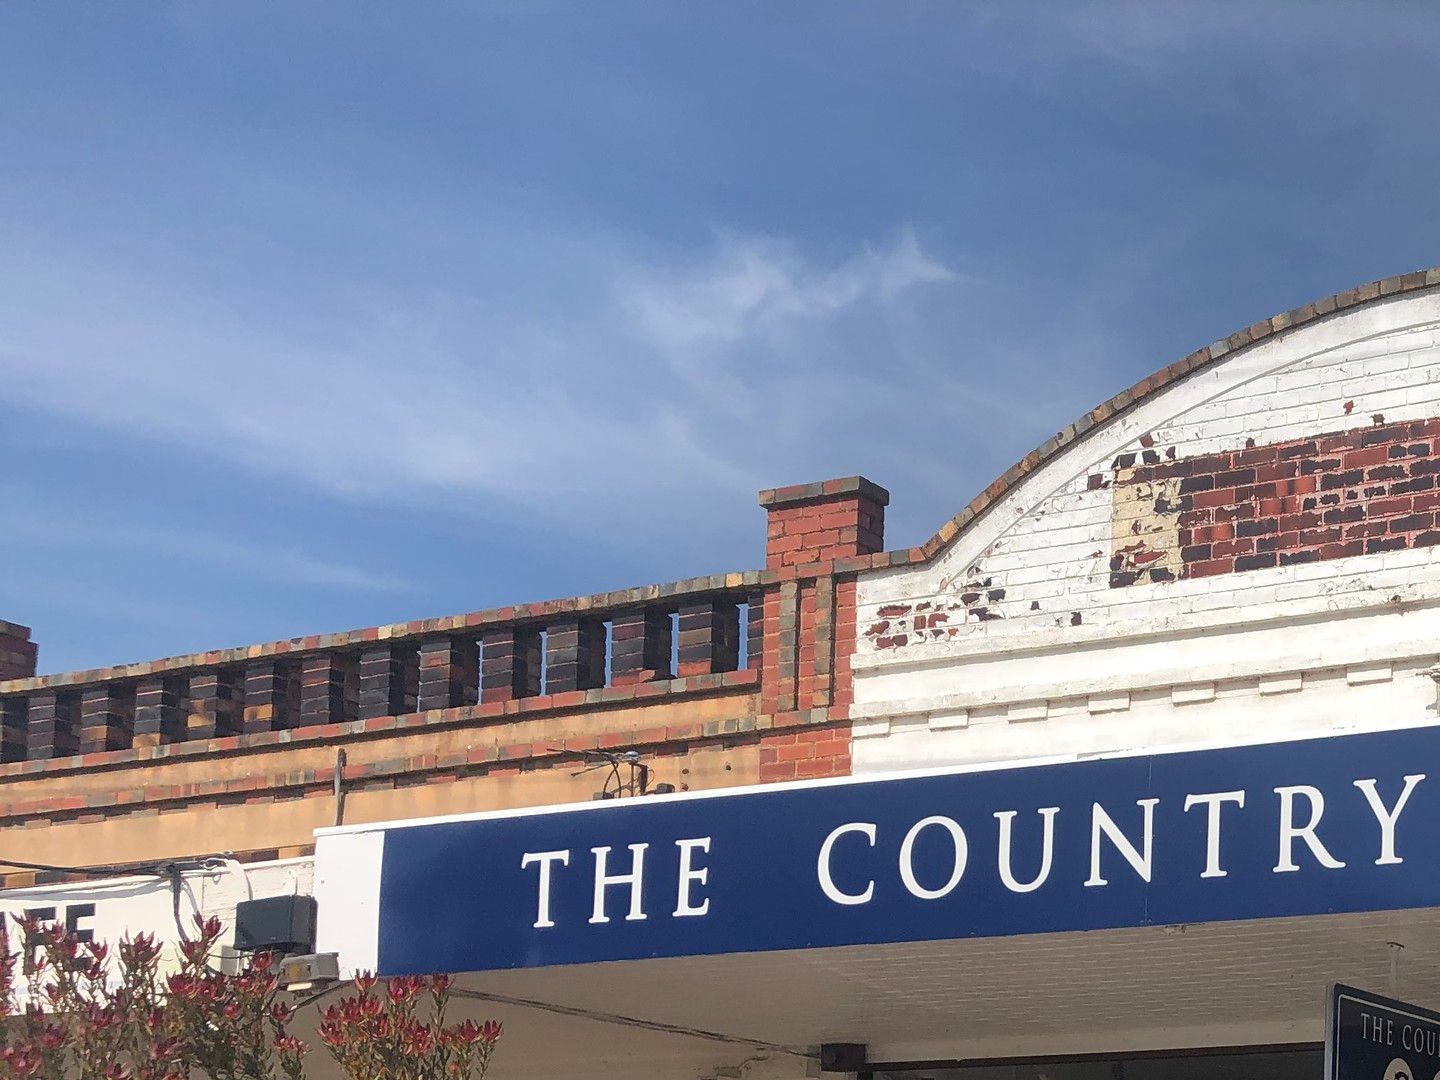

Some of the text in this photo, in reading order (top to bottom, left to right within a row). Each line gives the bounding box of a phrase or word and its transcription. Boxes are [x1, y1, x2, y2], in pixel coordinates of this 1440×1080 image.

[521, 836, 712, 929] THE
[817, 773, 1427, 906] COUNTRY
[1360, 1012, 1394, 1046] THE
